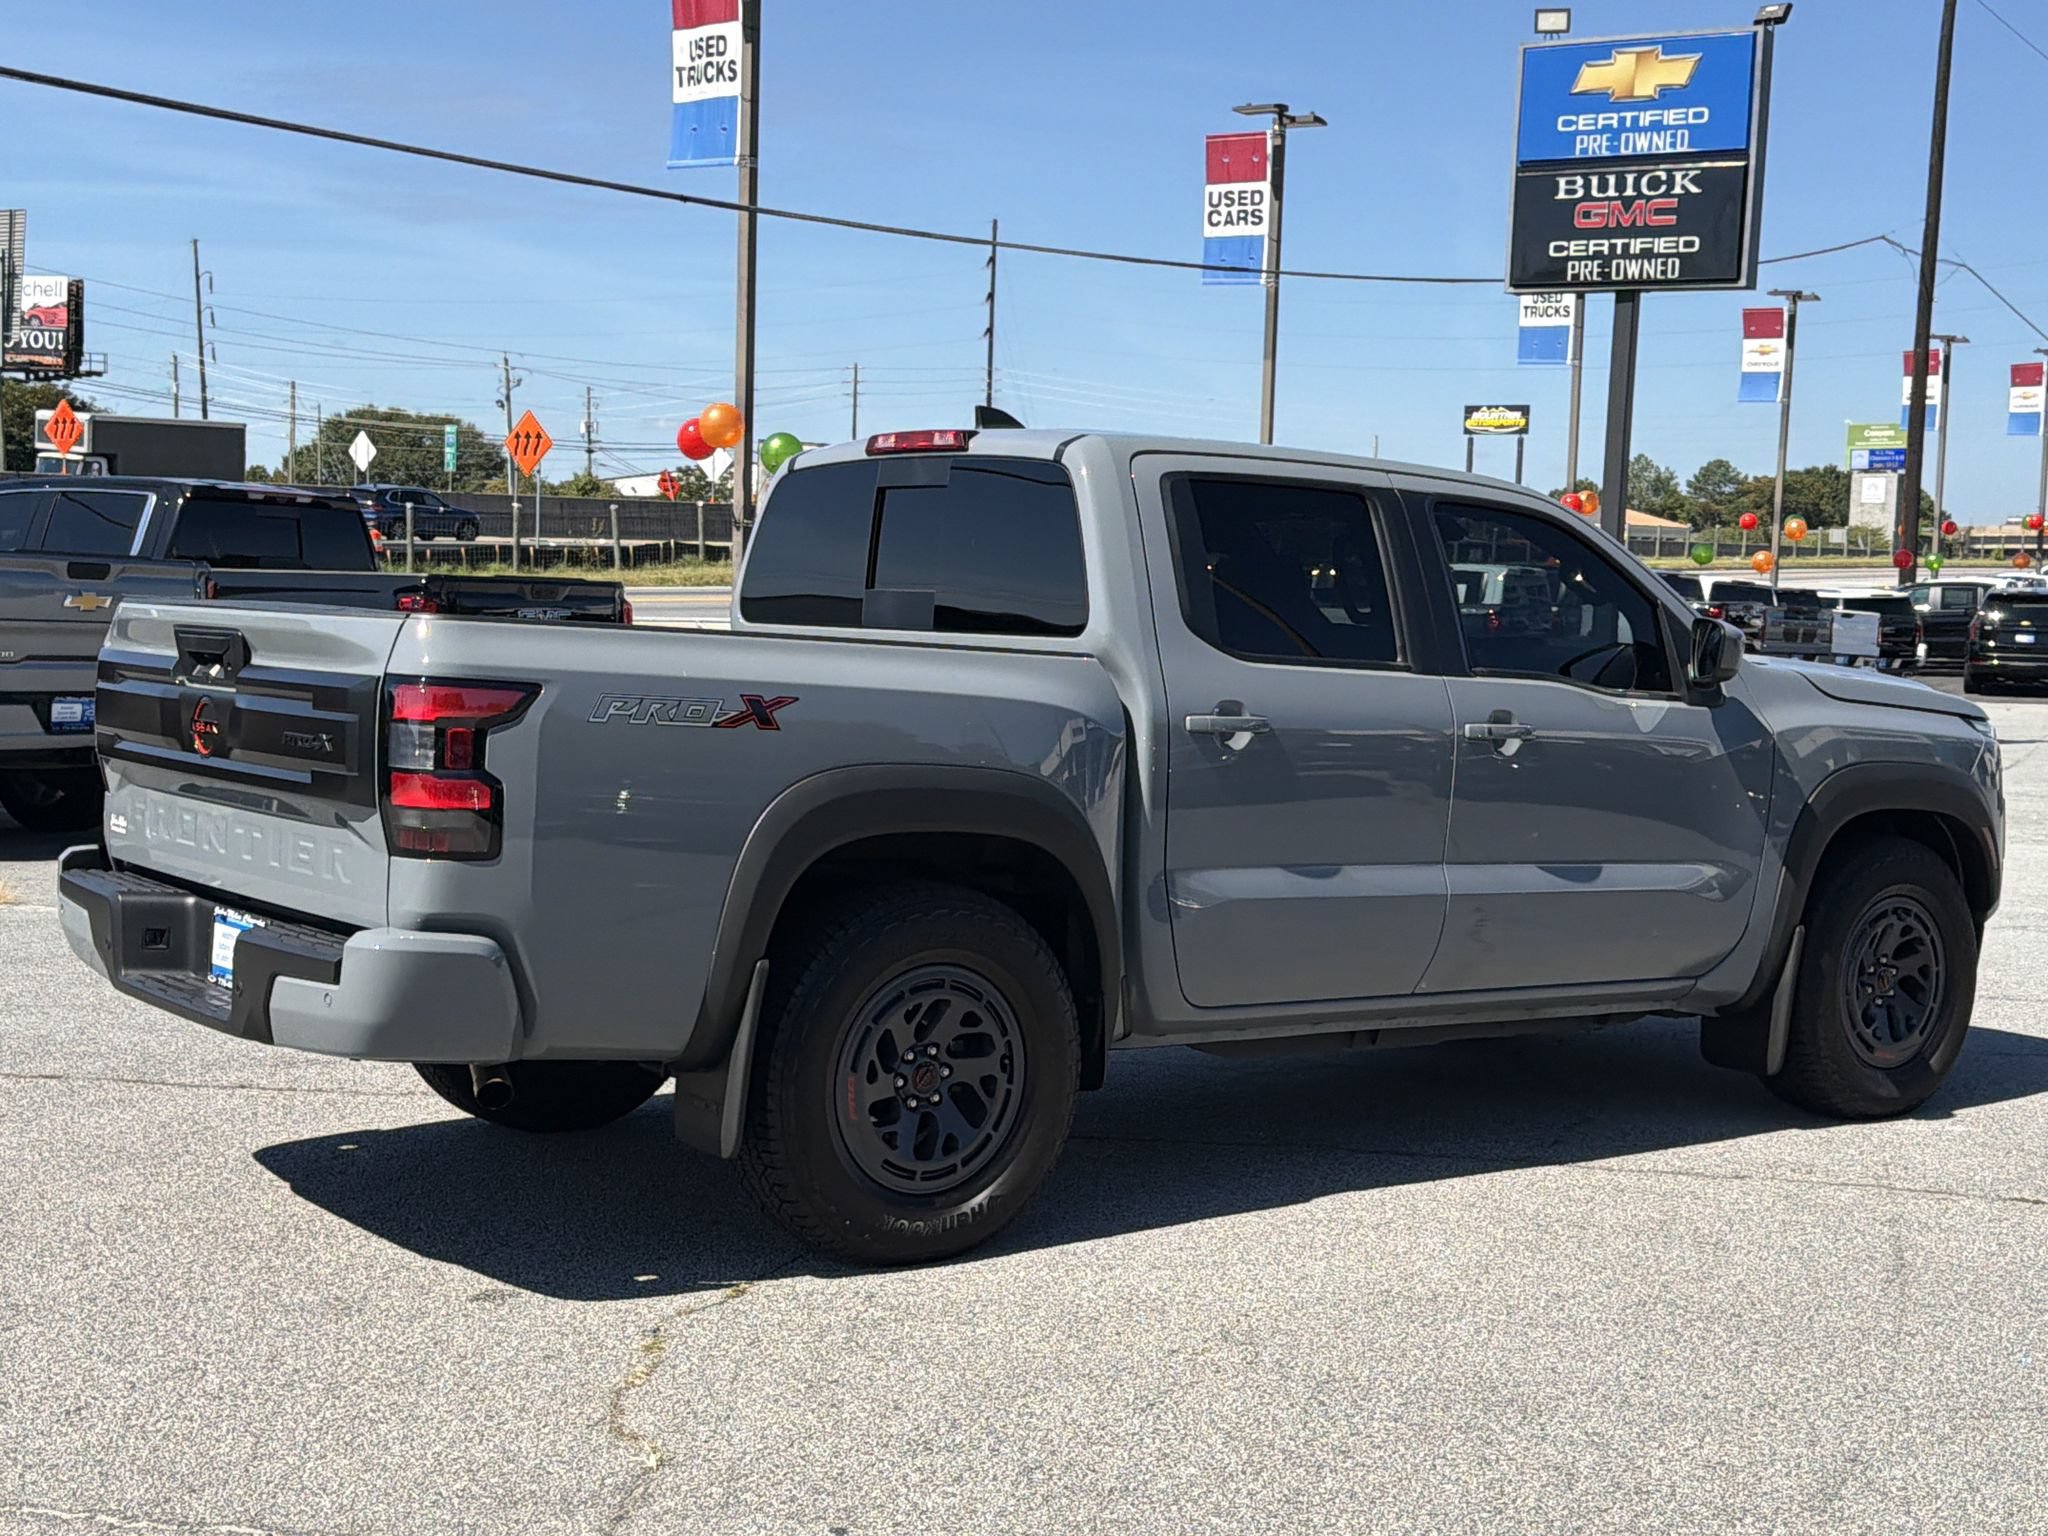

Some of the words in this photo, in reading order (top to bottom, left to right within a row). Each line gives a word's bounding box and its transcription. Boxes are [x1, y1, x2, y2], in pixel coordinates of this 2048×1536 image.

[689, 35, 727, 62] USED
[675, 59, 738, 88] TRUCKS
[1556, 107, 1709, 132] CERTIFIED
[1575, 129, 1689, 155] PRE-OWNED
[1554, 170, 1702, 200] BUICK
[1208, 189, 1264, 209] USED
[1207, 208, 1264, 227] CARS
[1573, 198, 1679, 229] GMC
[1548, 236, 1700, 258] CERTIFIED
[1566, 257, 1681, 282] PRE-OWNED
[1532, 293, 1563, 305] USED
[1523, 305, 1571, 319] TRUCKS
[20, 329, 64, 351] YOU!
[587, 693, 800, 731] PRO-X
[128, 795, 353, 885] FRONTIER
